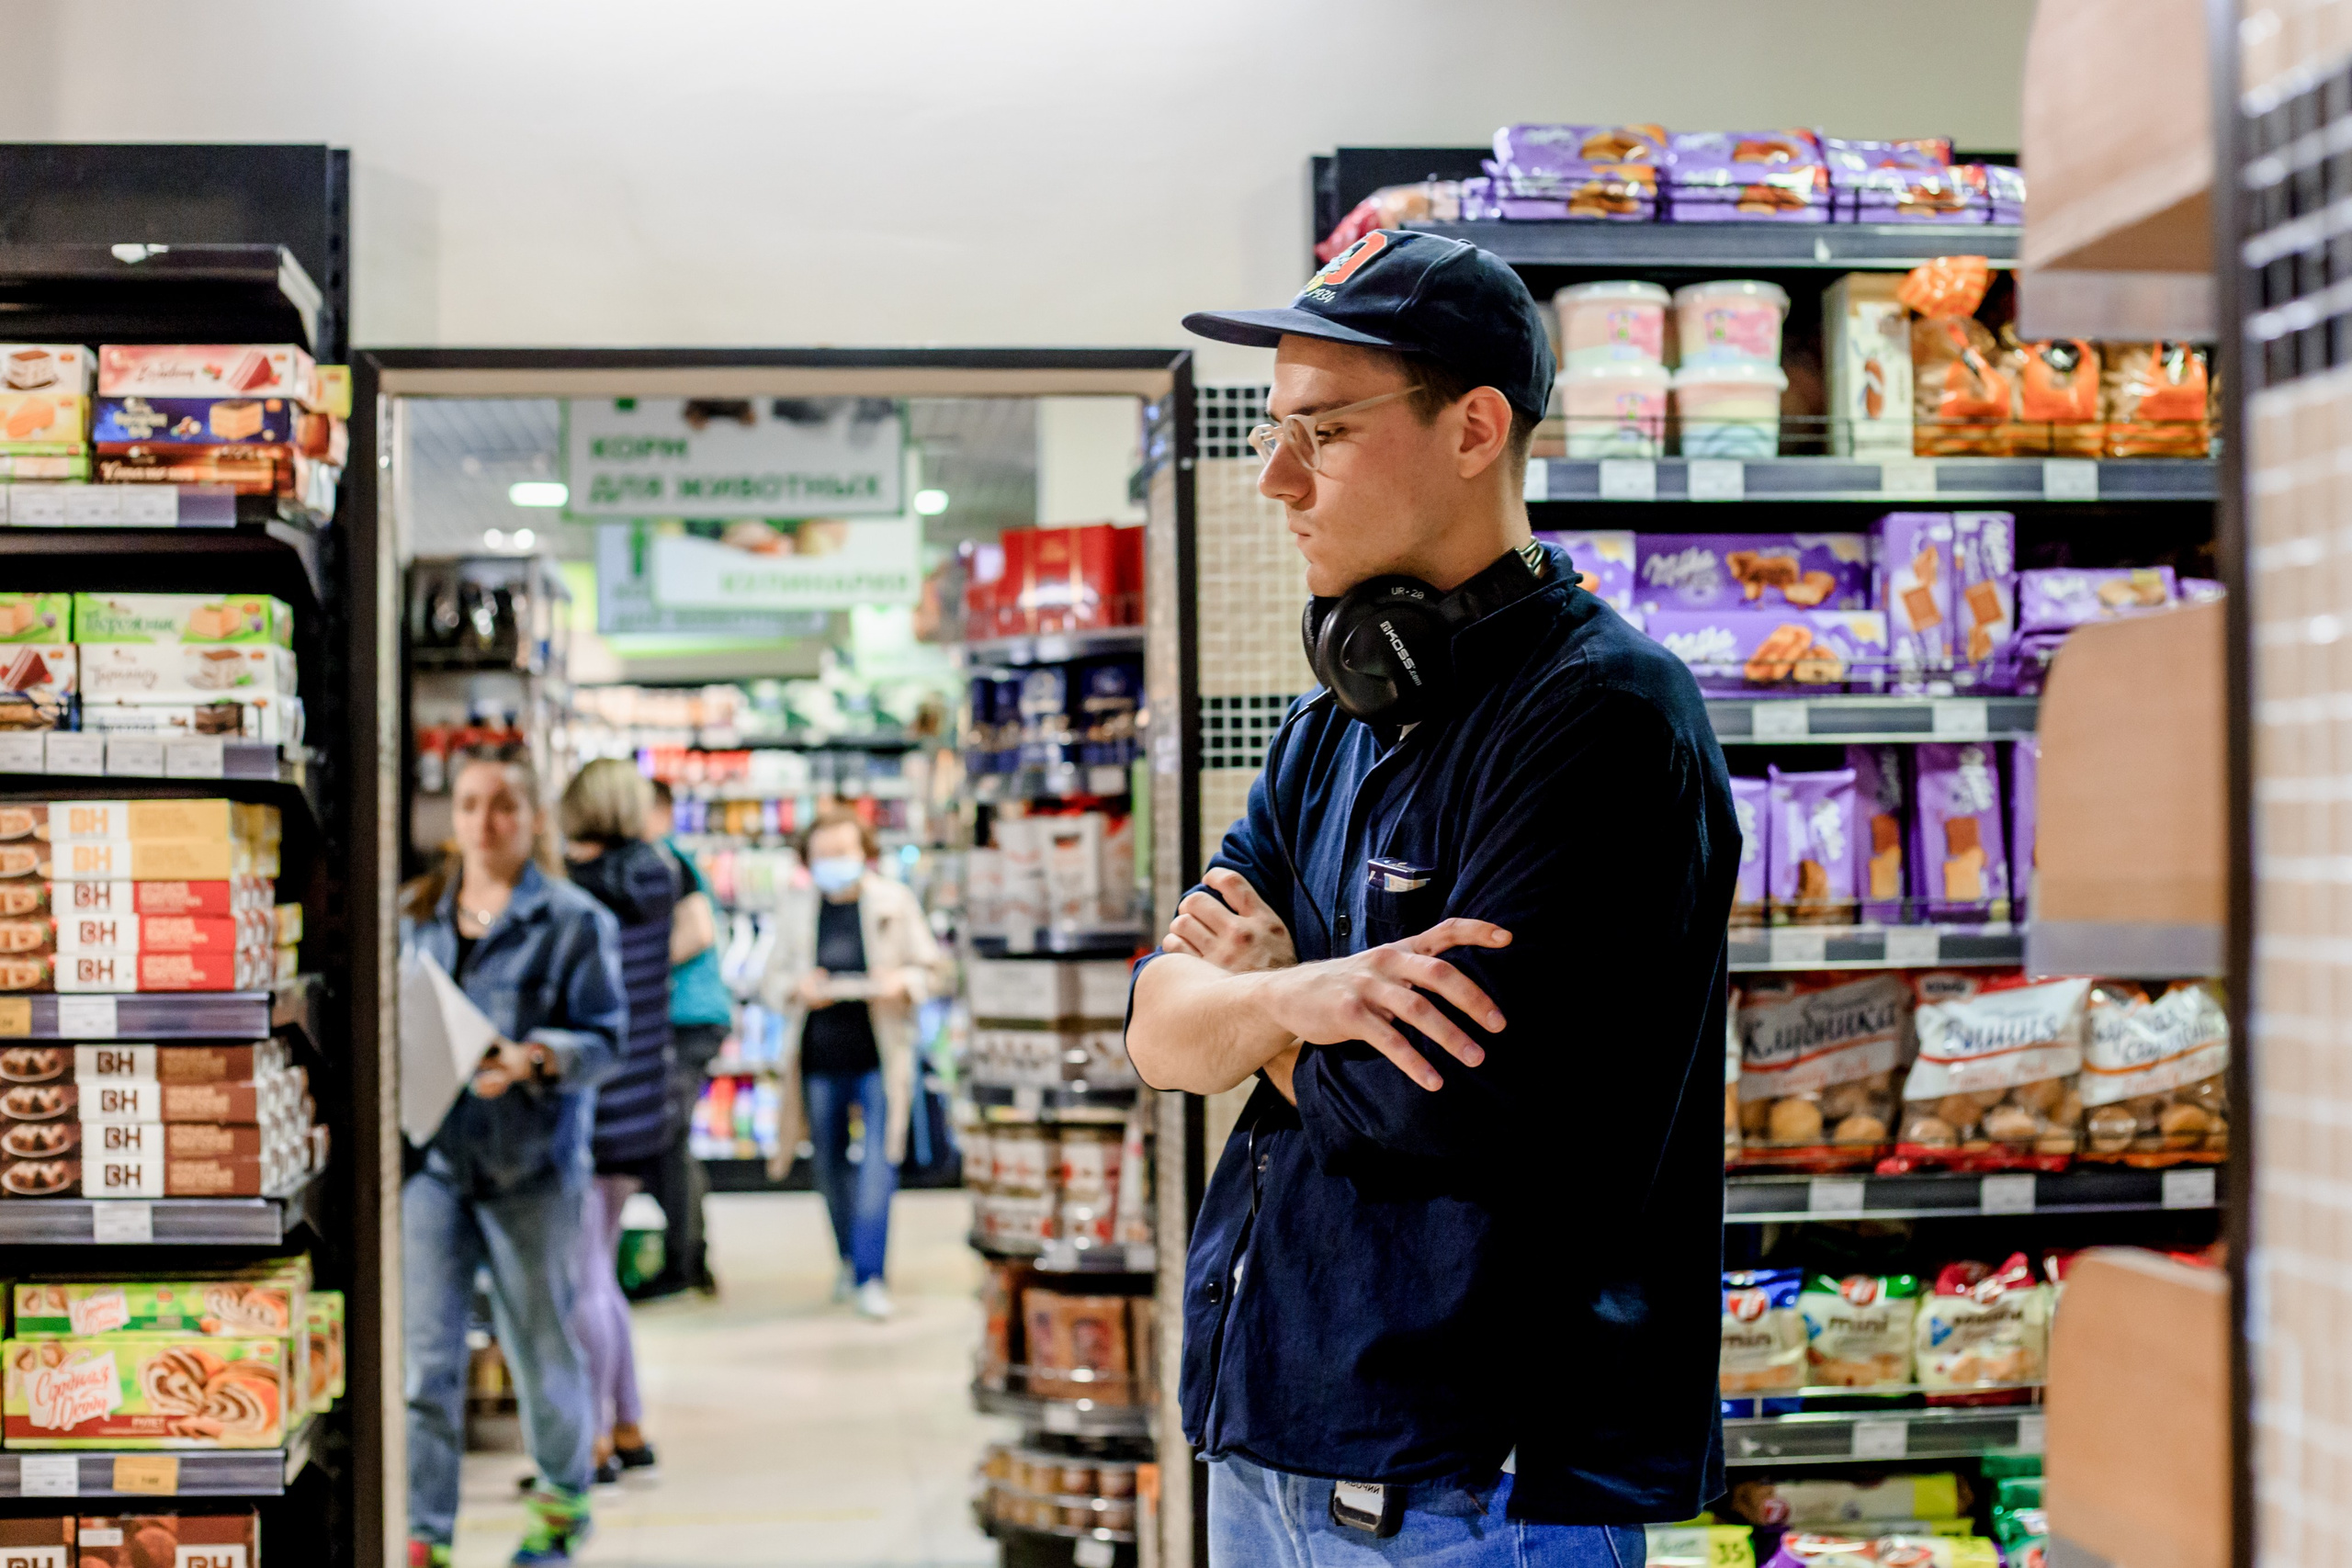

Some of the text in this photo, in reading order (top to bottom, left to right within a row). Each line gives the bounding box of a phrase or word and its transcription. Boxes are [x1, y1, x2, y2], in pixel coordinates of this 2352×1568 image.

[589, 436, 689, 459] КОРМ
[589, 473, 881, 502] ДЛЯ ЖИВОТНЫХ
